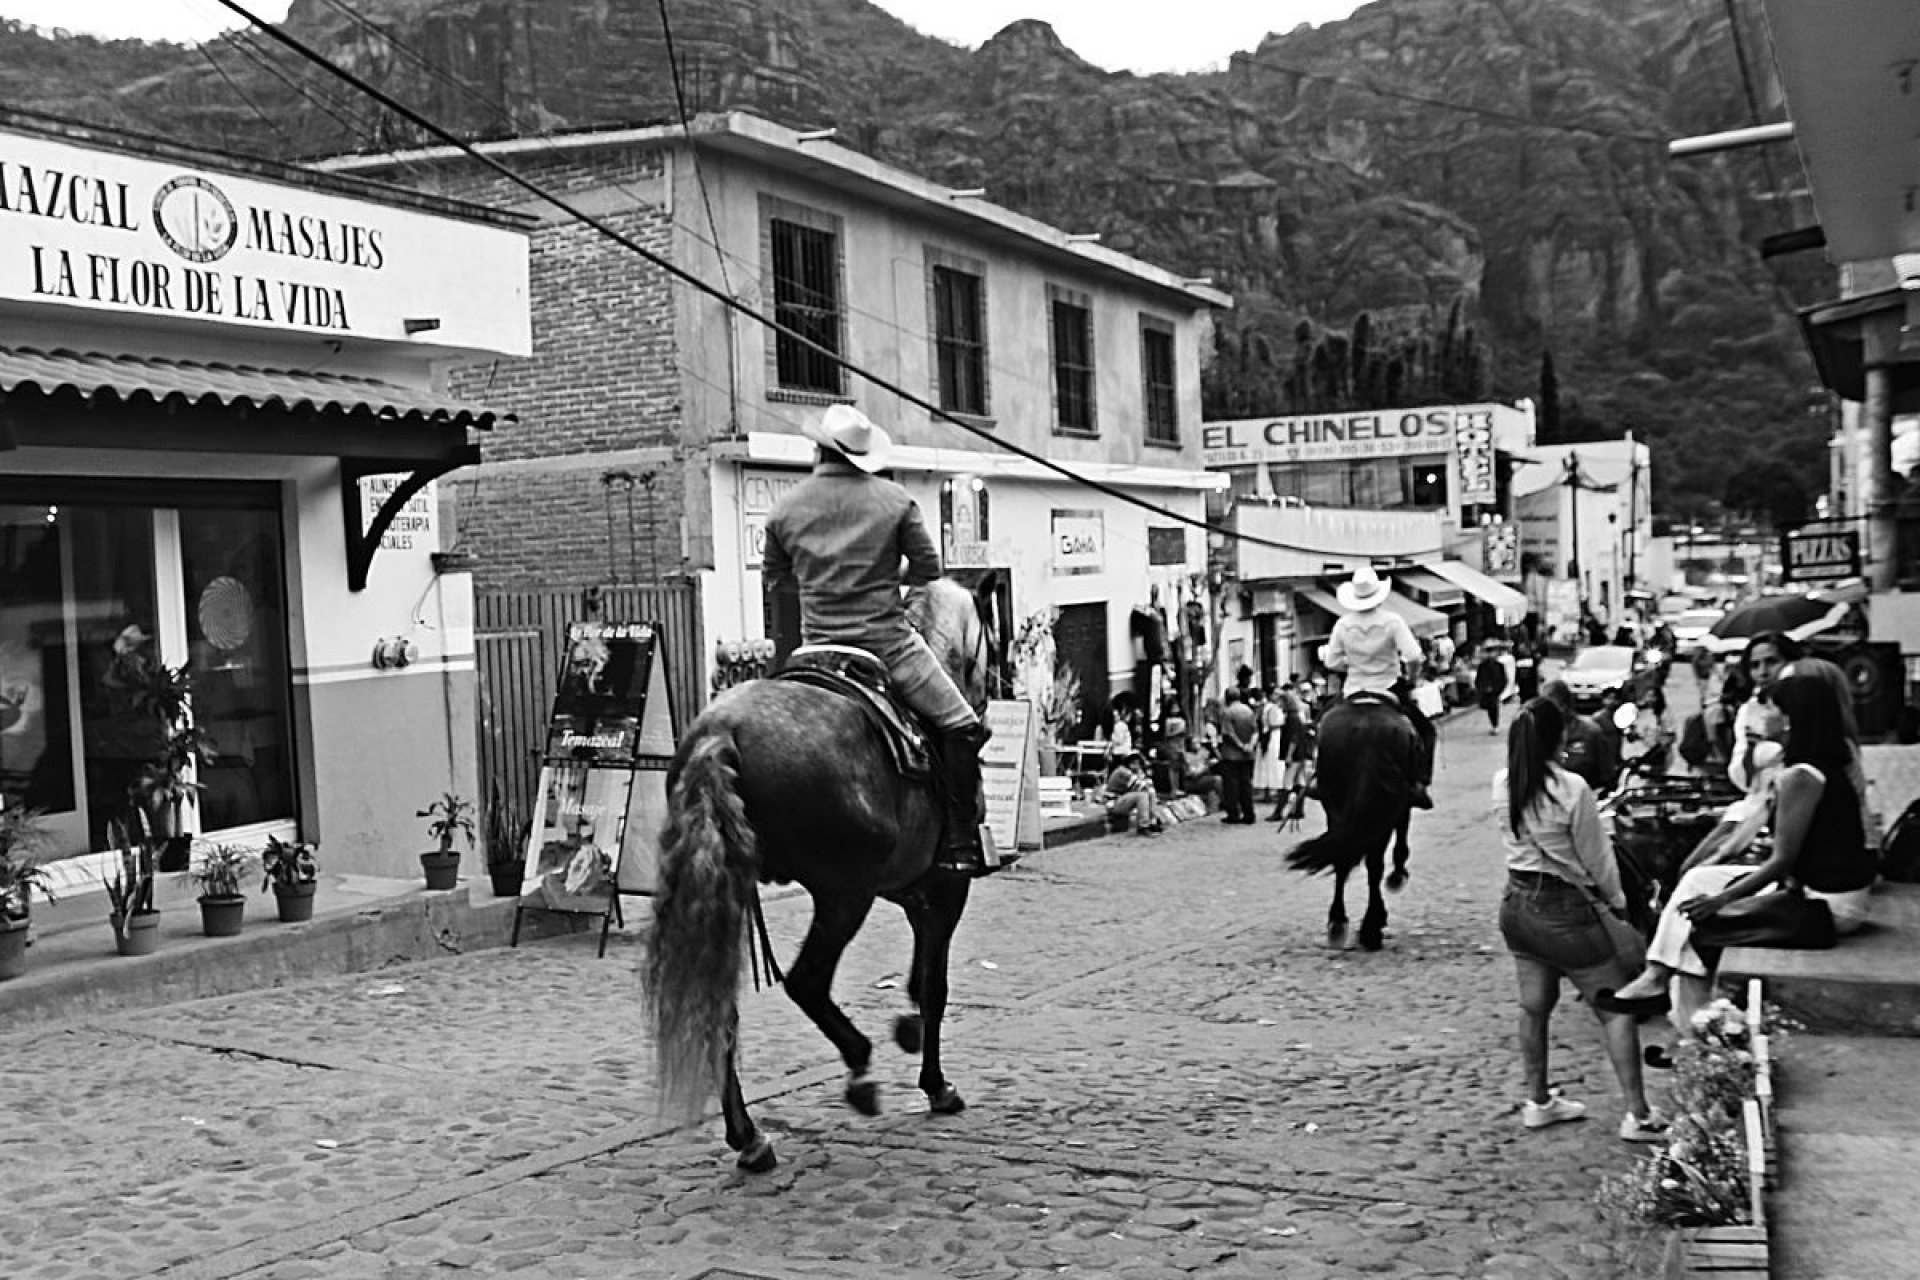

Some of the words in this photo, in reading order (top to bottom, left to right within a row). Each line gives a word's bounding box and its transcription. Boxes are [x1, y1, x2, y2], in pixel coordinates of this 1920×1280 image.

[246, 206, 384, 270] MASAJES
[31, 246, 77, 298] LA
[88, 254, 174, 310] FLOR
[184, 268, 222, 314] DE
[234, 275, 272, 321] LA
[278, 281, 350, 329] VIDA
[1203, 426, 1248, 449] EL
[1263, 411, 1449, 446] CHINELOS
[745, 476, 800, 508] CENT
[388, 516, 431, 531] OTERAPIA
[746, 523, 766, 556] Te
[379, 535, 414, 550] CIALES
[561, 730, 625, 748] Temazcal
